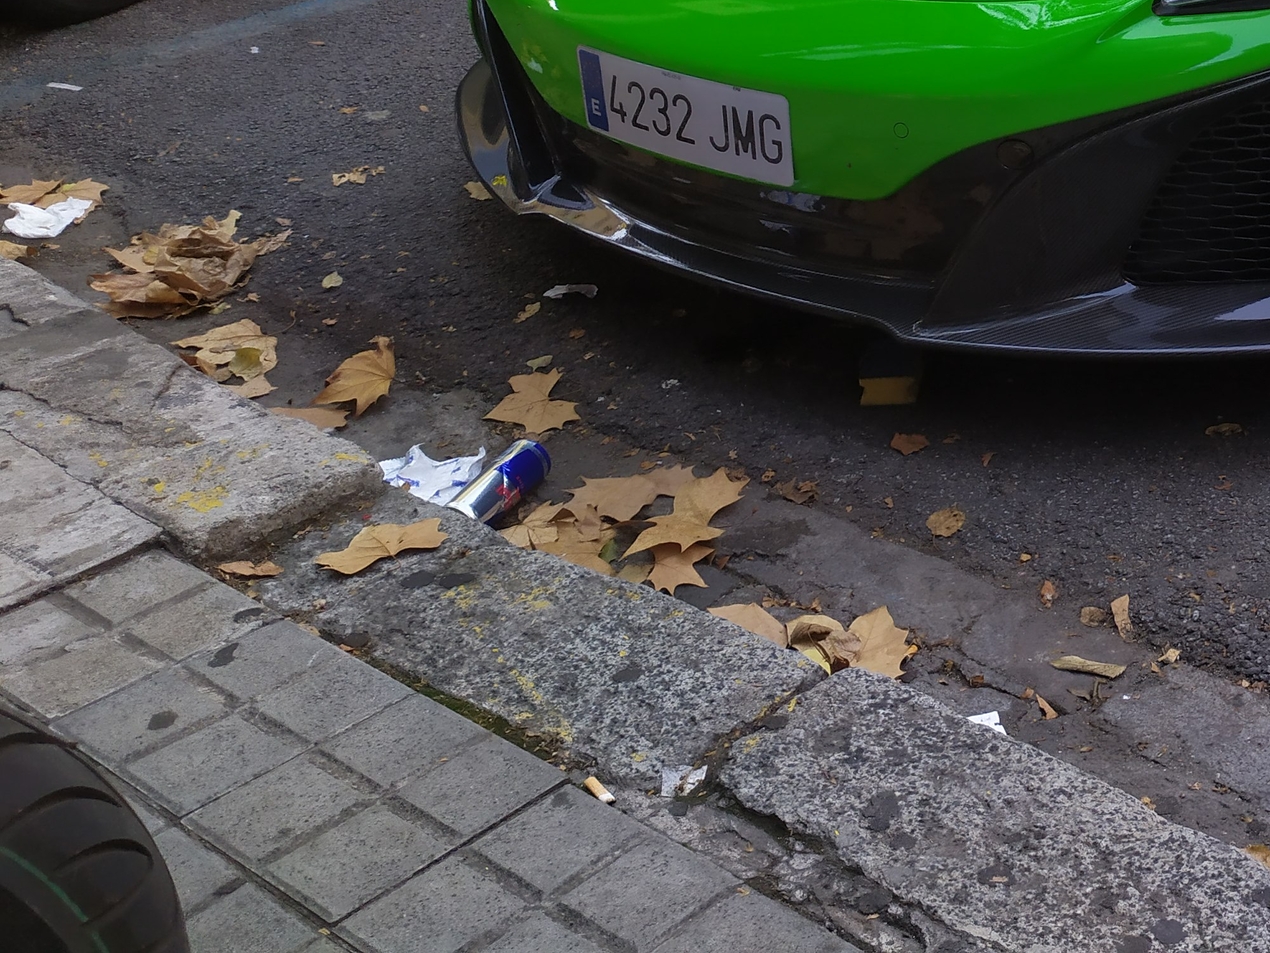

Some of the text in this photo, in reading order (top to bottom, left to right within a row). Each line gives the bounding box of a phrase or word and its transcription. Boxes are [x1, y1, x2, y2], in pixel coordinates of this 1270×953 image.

[590, 98, 602, 117] E
[609, 74, 784, 165] 4232 JMG
